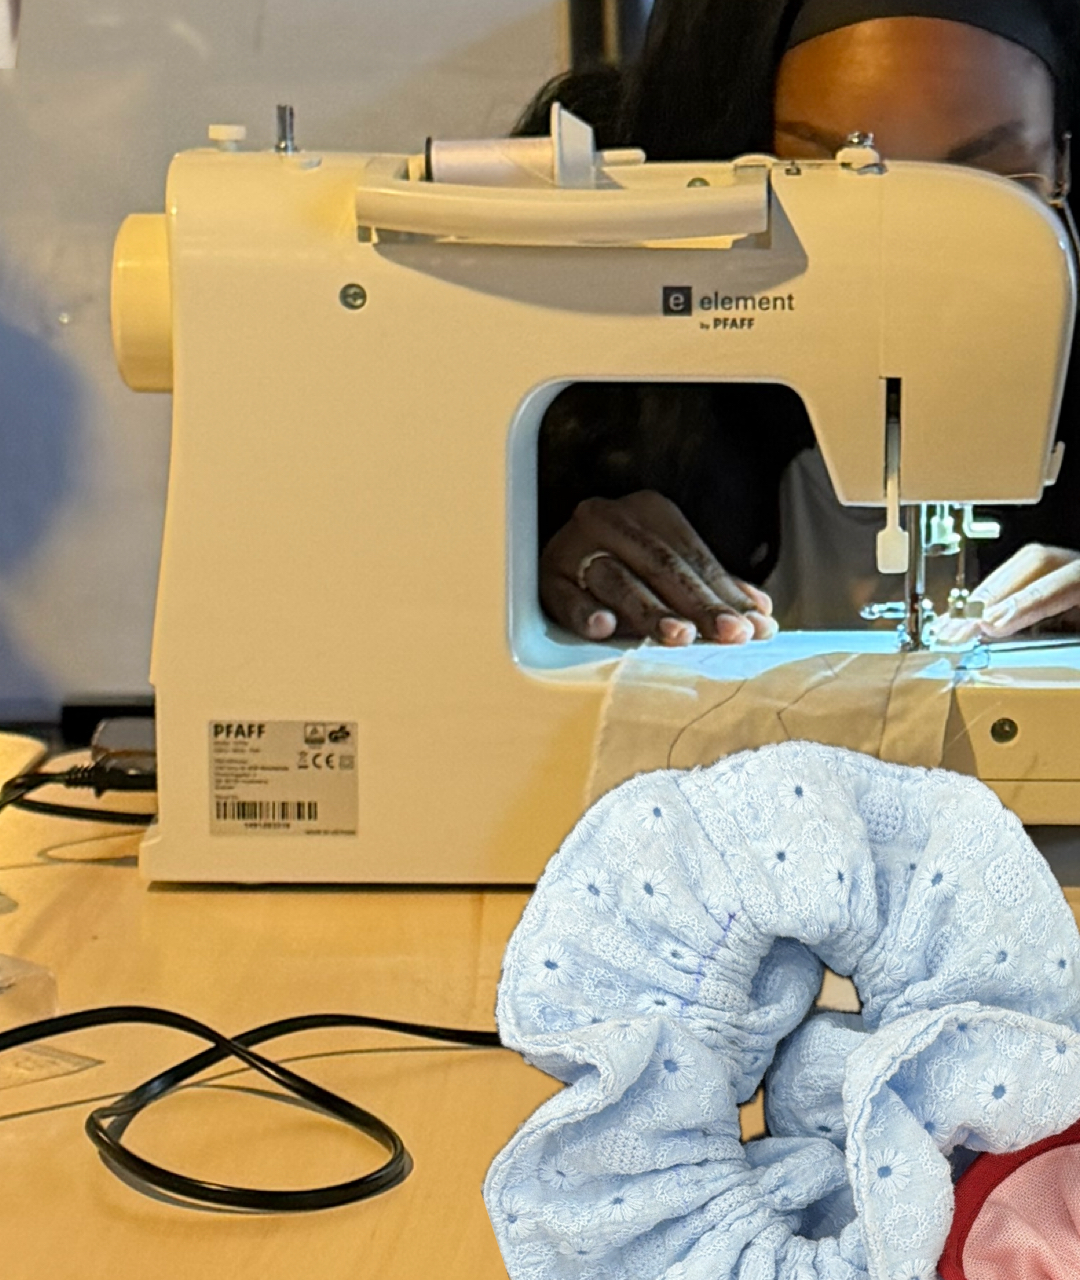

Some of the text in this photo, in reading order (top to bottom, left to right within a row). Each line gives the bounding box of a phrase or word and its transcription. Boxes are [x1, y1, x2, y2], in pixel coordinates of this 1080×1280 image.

[700, 291, 795, 311] element
[713, 317, 754, 330] PFAFF
[213, 723, 266, 739] PFAFF
